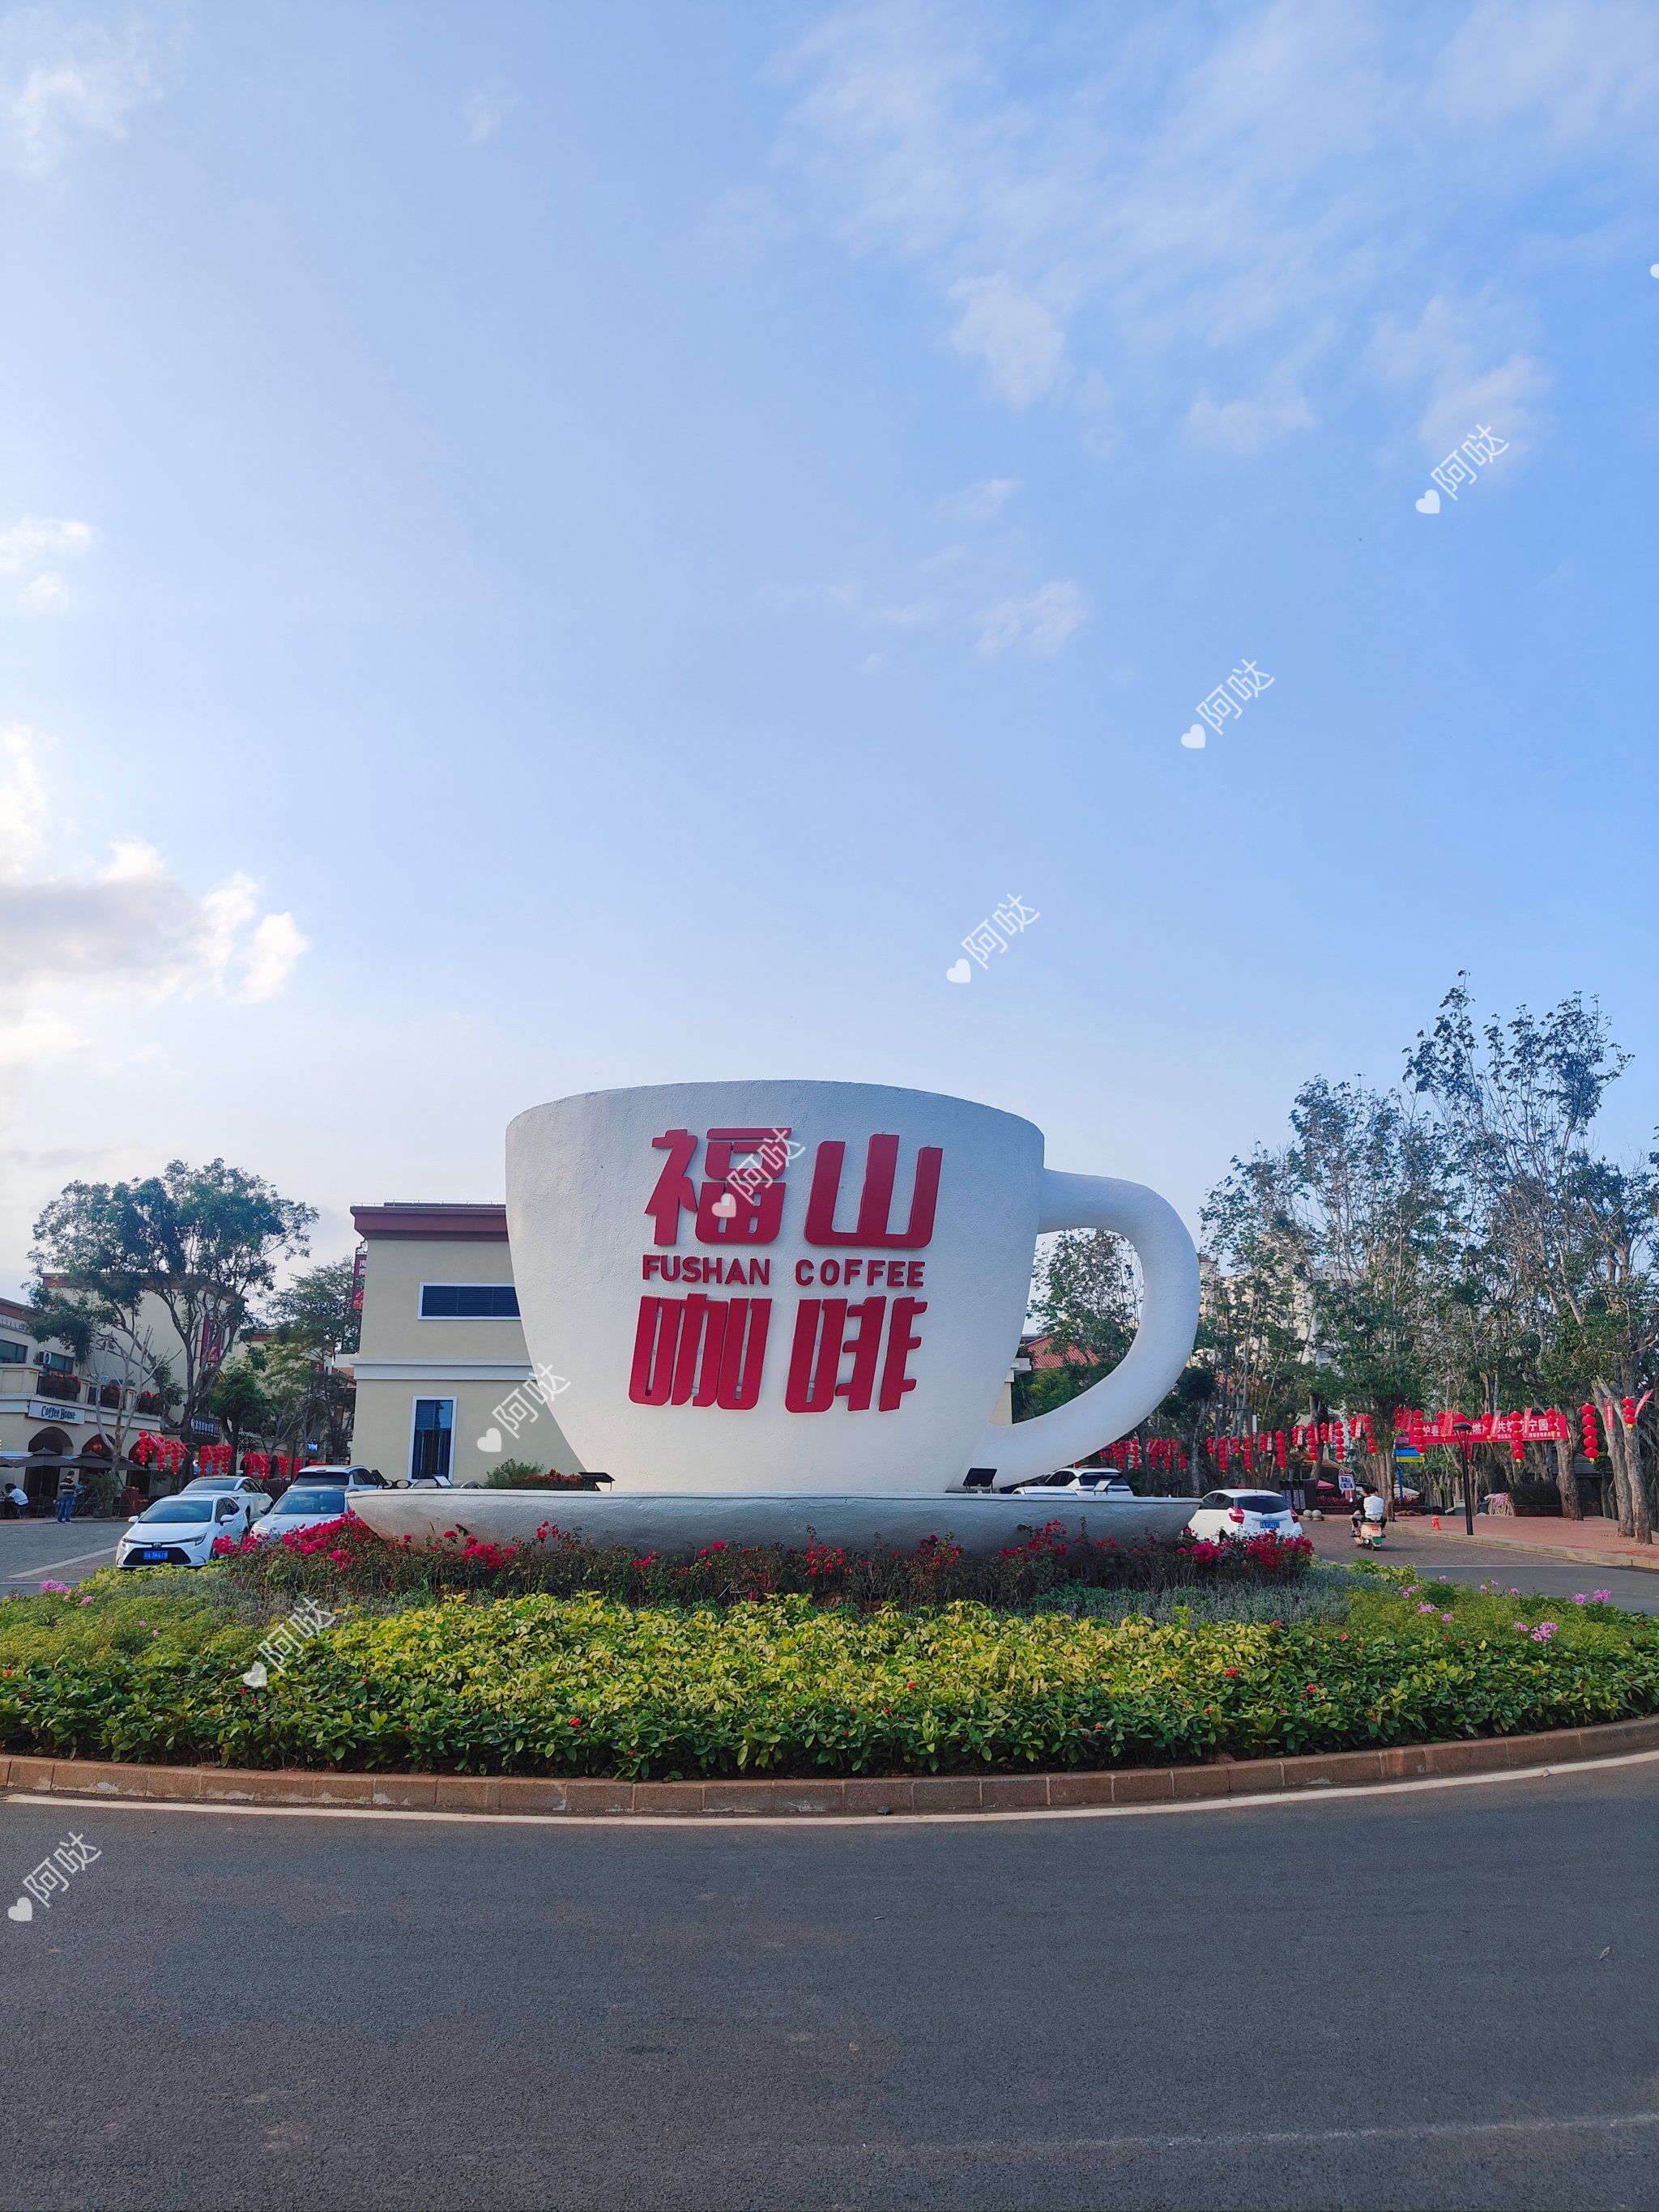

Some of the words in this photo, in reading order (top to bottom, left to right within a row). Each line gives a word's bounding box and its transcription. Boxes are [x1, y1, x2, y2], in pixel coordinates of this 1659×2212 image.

[644, 1127, 944, 1248] 福山
[642, 1254, 770, 1286] FUSHAN
[795, 1258, 926, 1288] COFFEE
[629, 1293, 928, 1413] 咖啡
[41, 1405, 60, 1419] Coffee
